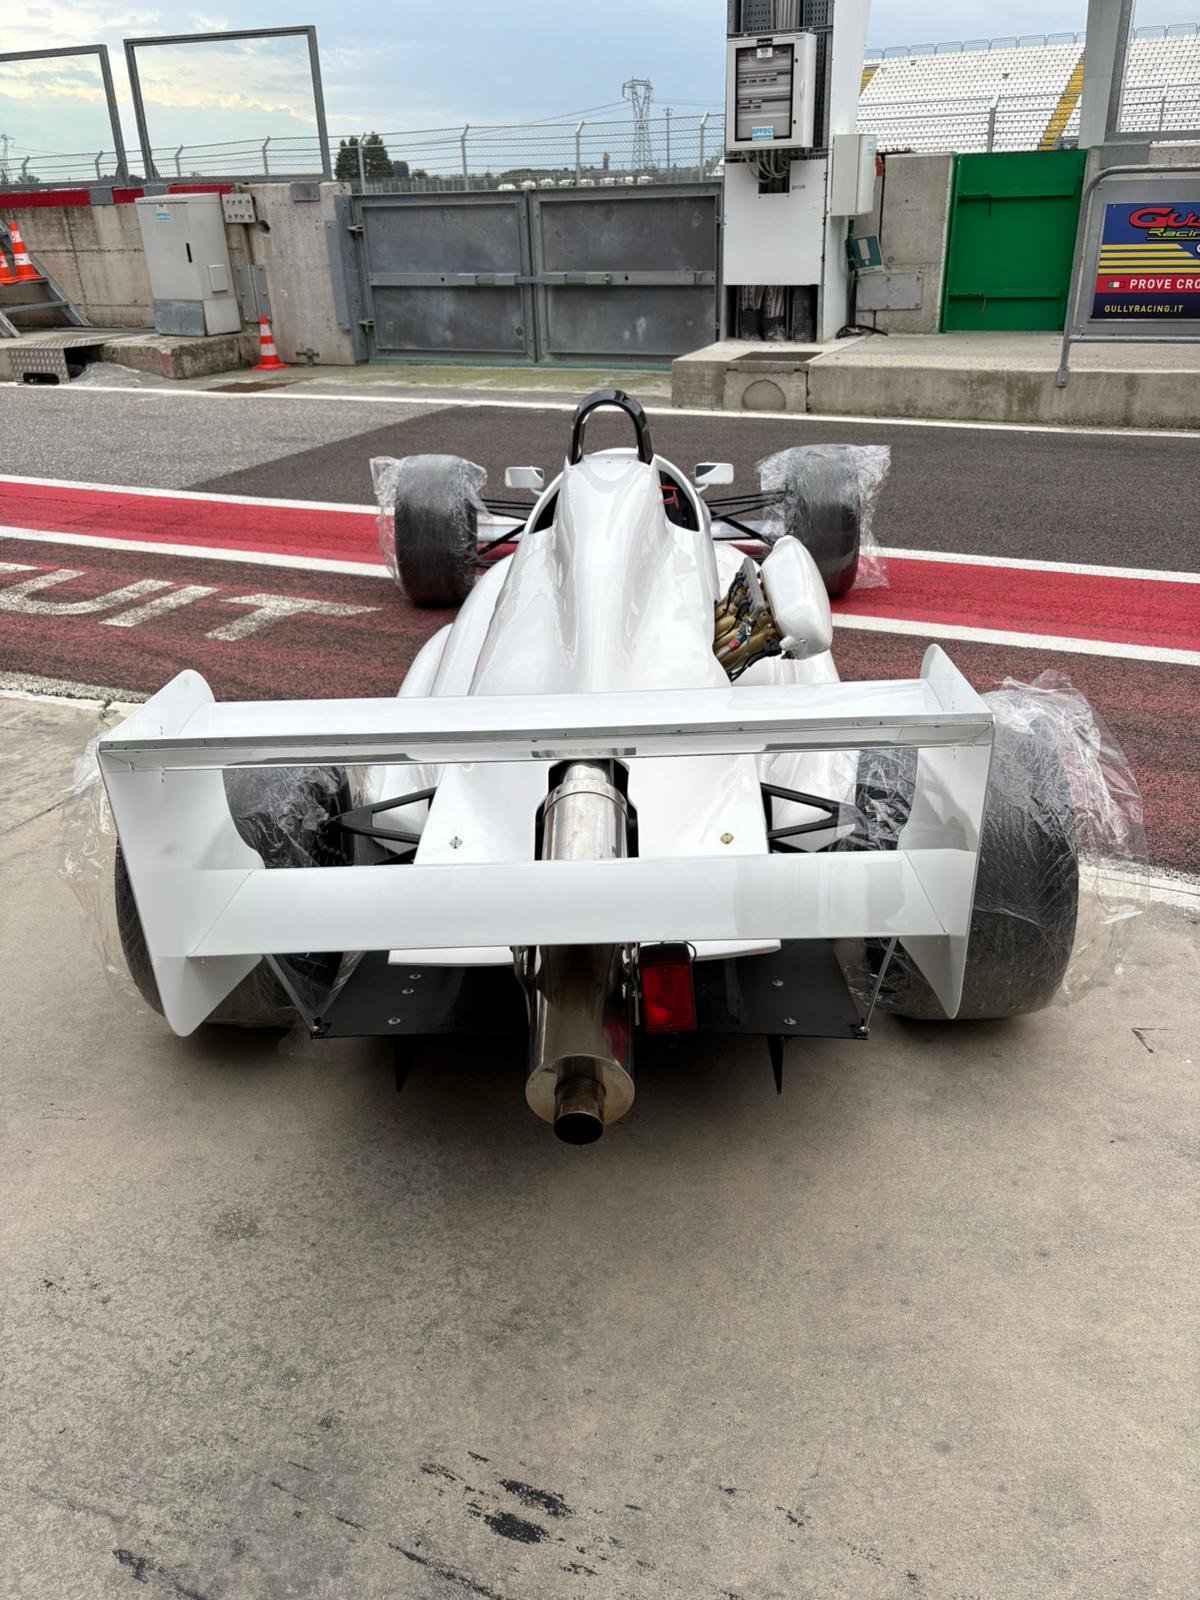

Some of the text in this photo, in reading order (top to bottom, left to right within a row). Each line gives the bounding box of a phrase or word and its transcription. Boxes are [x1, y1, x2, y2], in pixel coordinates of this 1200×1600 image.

[1129, 279, 1172, 289] PROVE
[1104, 305, 1184, 313] GULLYRACING.IT
[0, 562, 382, 641] UIT
